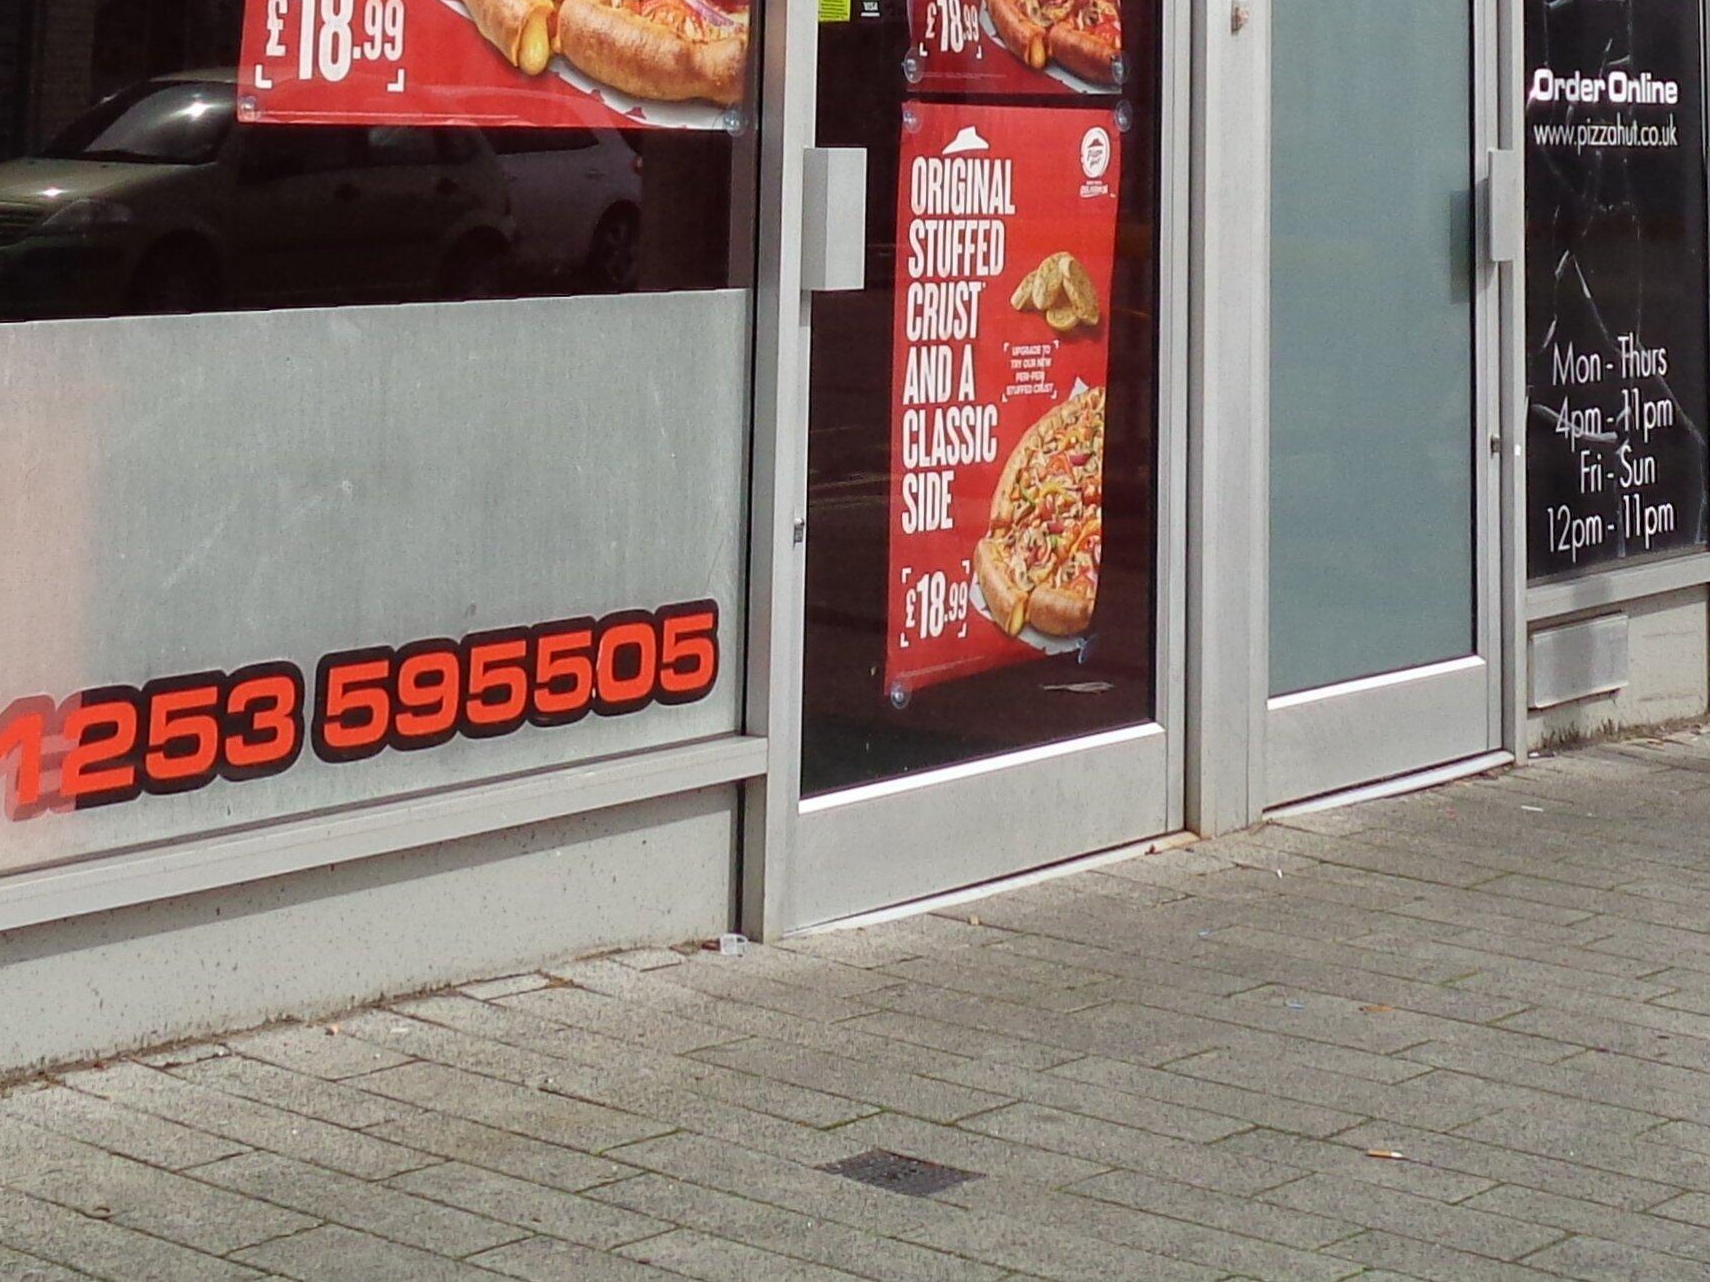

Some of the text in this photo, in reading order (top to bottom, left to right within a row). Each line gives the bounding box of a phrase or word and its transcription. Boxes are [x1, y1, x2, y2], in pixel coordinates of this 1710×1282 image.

[1532, 68, 1679, 107] Order Online
[1533, 112, 1679, 157] www.pizzahut.co.uk
[910, 156, 1016, 215] ORIGINAL
[908, 219, 1006, 278] STUFFED
[902, 344, 976, 405] AND A
[1552, 340, 1601, 386] Mon
[1617, 332, 1668, 379] Thurs
[902, 404, 999, 469] CLASSIC
[1555, 397, 1602, 453] 4pm
[1621, 389, 1674, 440] 11pm
[1579, 450, 1602, 494] Fri
[1618, 446, 1656, 489] Sun
[902, 470, 953, 534] SIDE
[1546, 506, 1603, 563] 12pm
[1622, 496, 1675, 550] 11pm
[905, 569, 969, 640] £18.99
[311, 600, 721, 763] 595505
